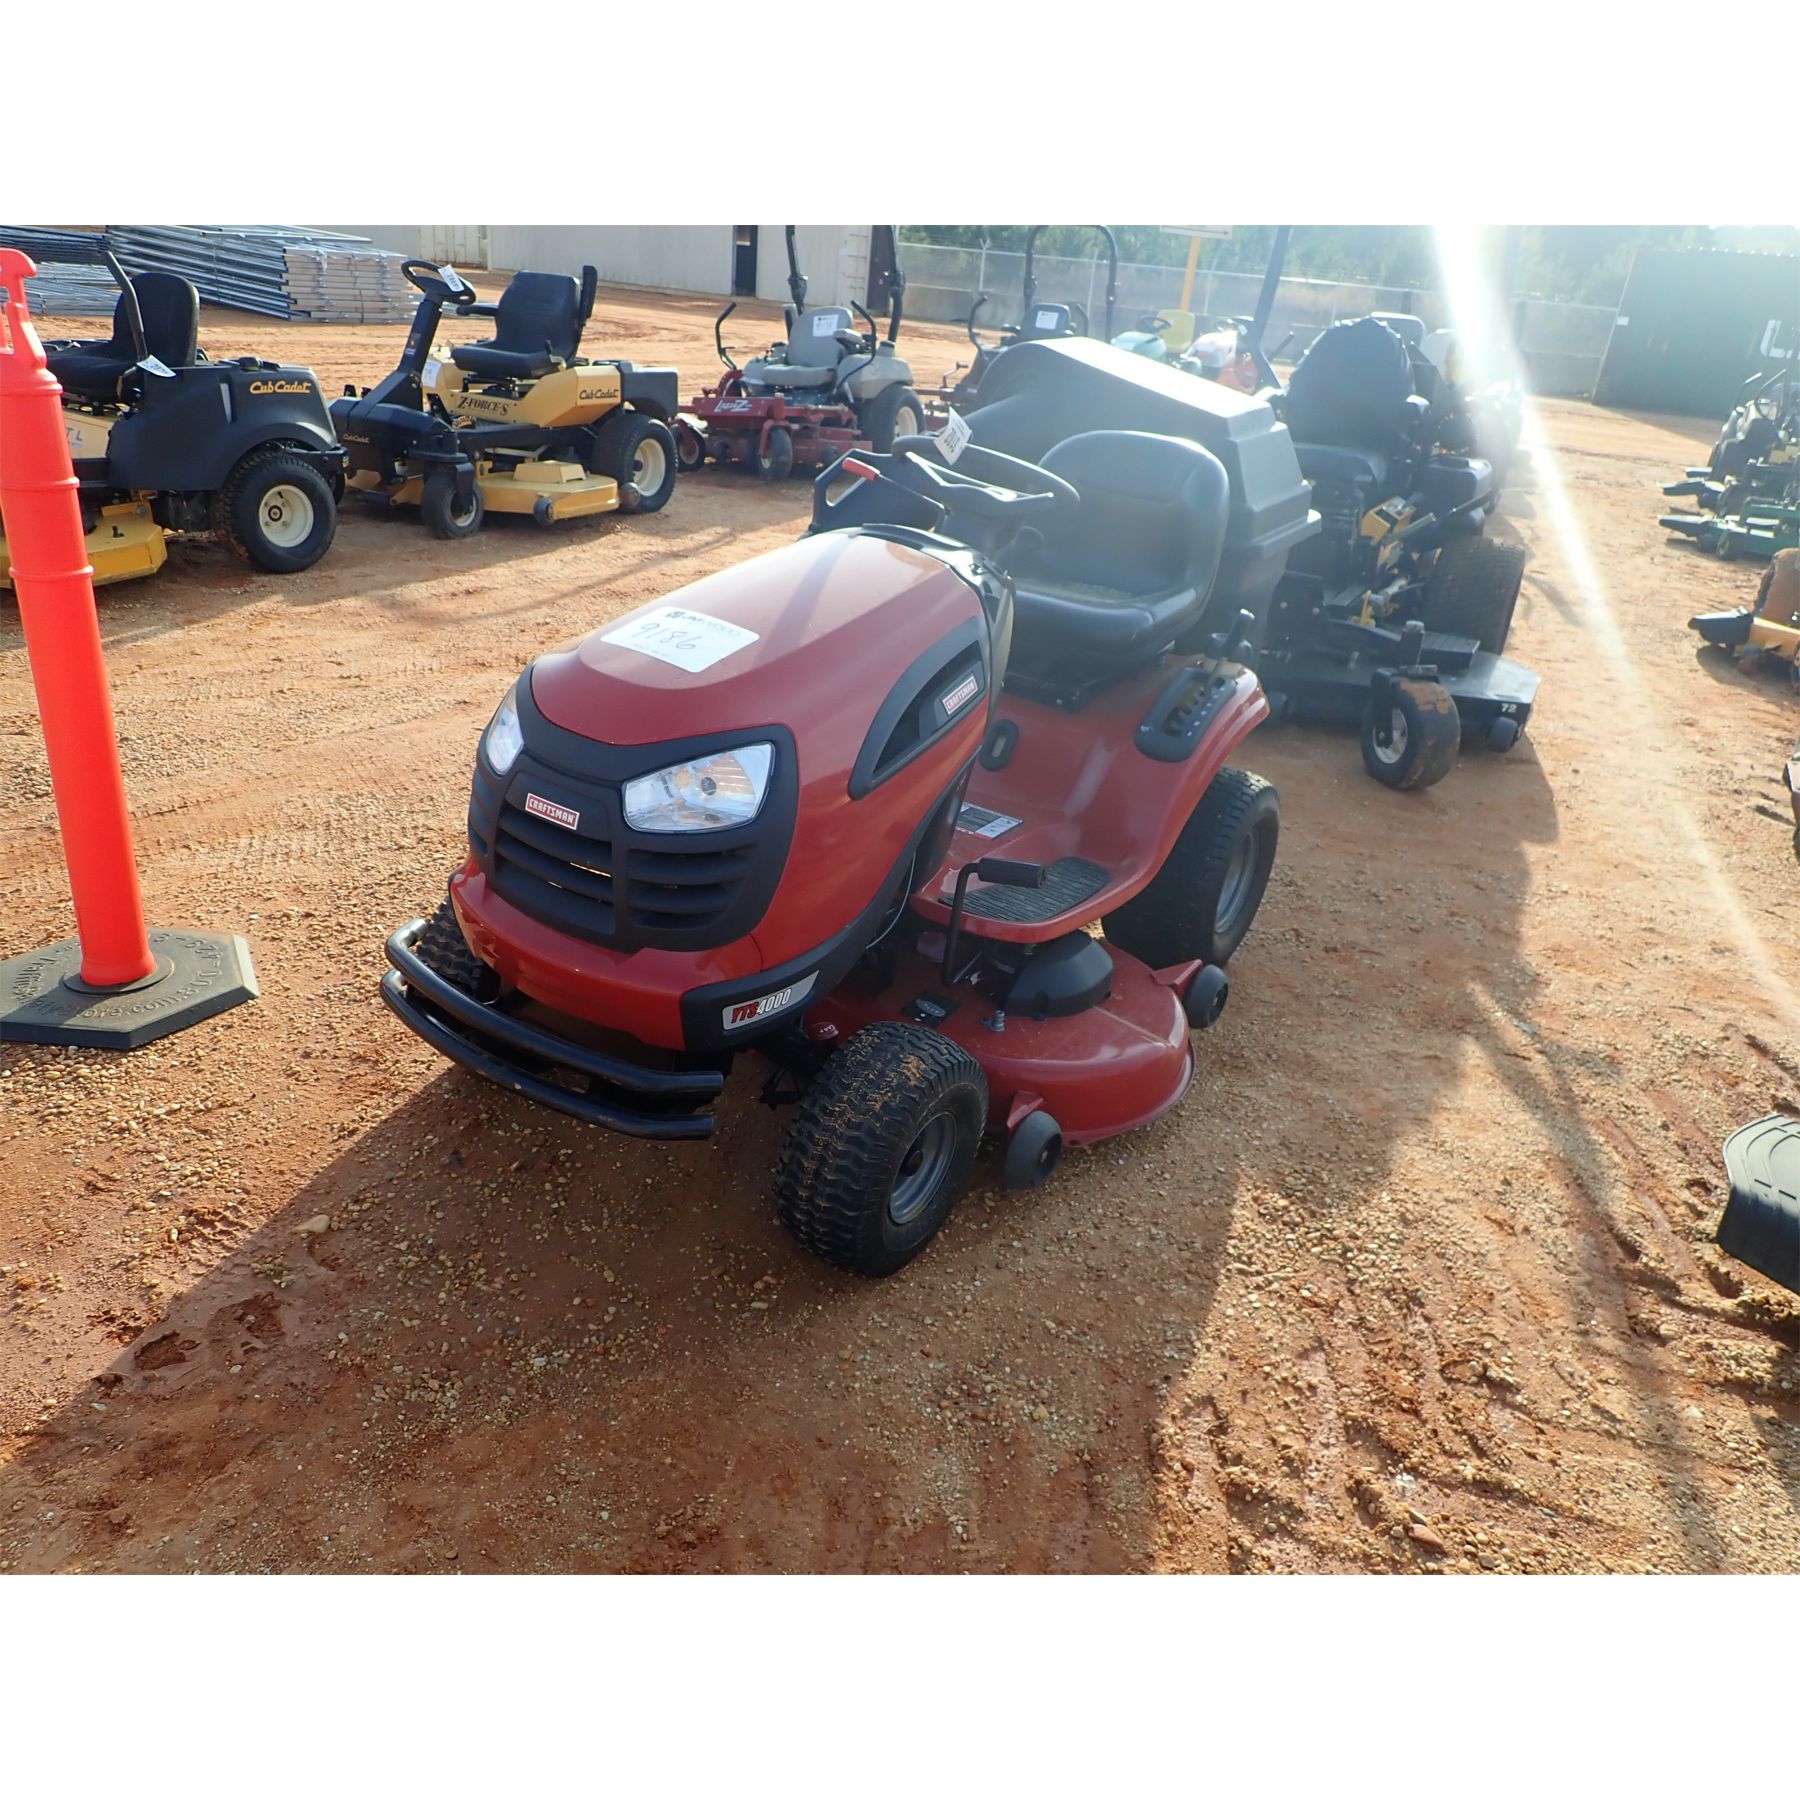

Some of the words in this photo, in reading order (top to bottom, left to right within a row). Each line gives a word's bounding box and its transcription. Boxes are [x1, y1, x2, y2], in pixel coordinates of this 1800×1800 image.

[250, 380, 274, 394] Cub
[275, 380, 312, 393] Cadet
[1501, 703, 1517, 713] 72
[528, 798, 574, 823] CRAFTSMAN
